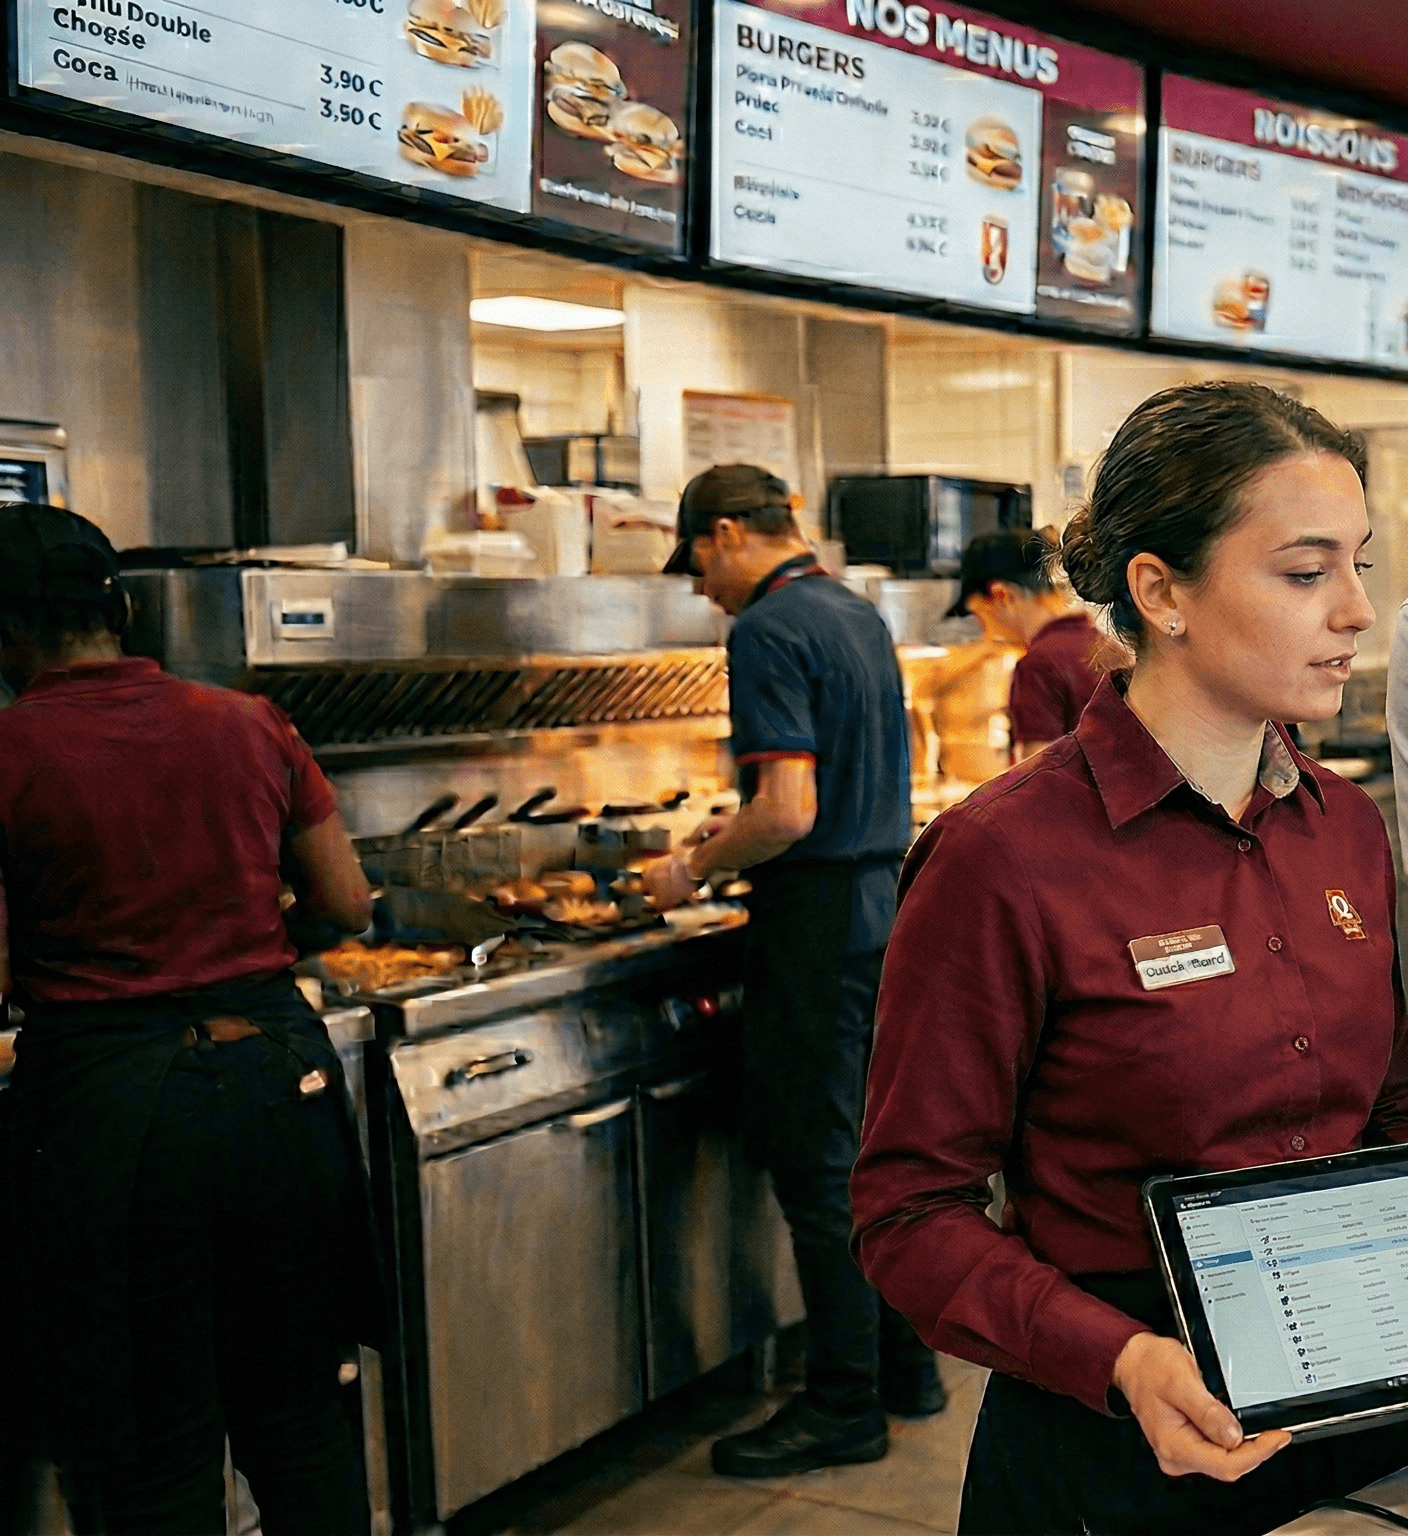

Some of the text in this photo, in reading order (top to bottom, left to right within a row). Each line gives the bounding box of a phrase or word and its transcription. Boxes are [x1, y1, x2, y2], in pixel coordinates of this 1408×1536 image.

[128, 2, 211, 43] Double
[846, 0, 1059, 84] NOS MENUS
[737, 24, 864, 79] BURGERS
[320, 63, 365, 92] 3,90
[320, 97, 364, 125] 3,50
